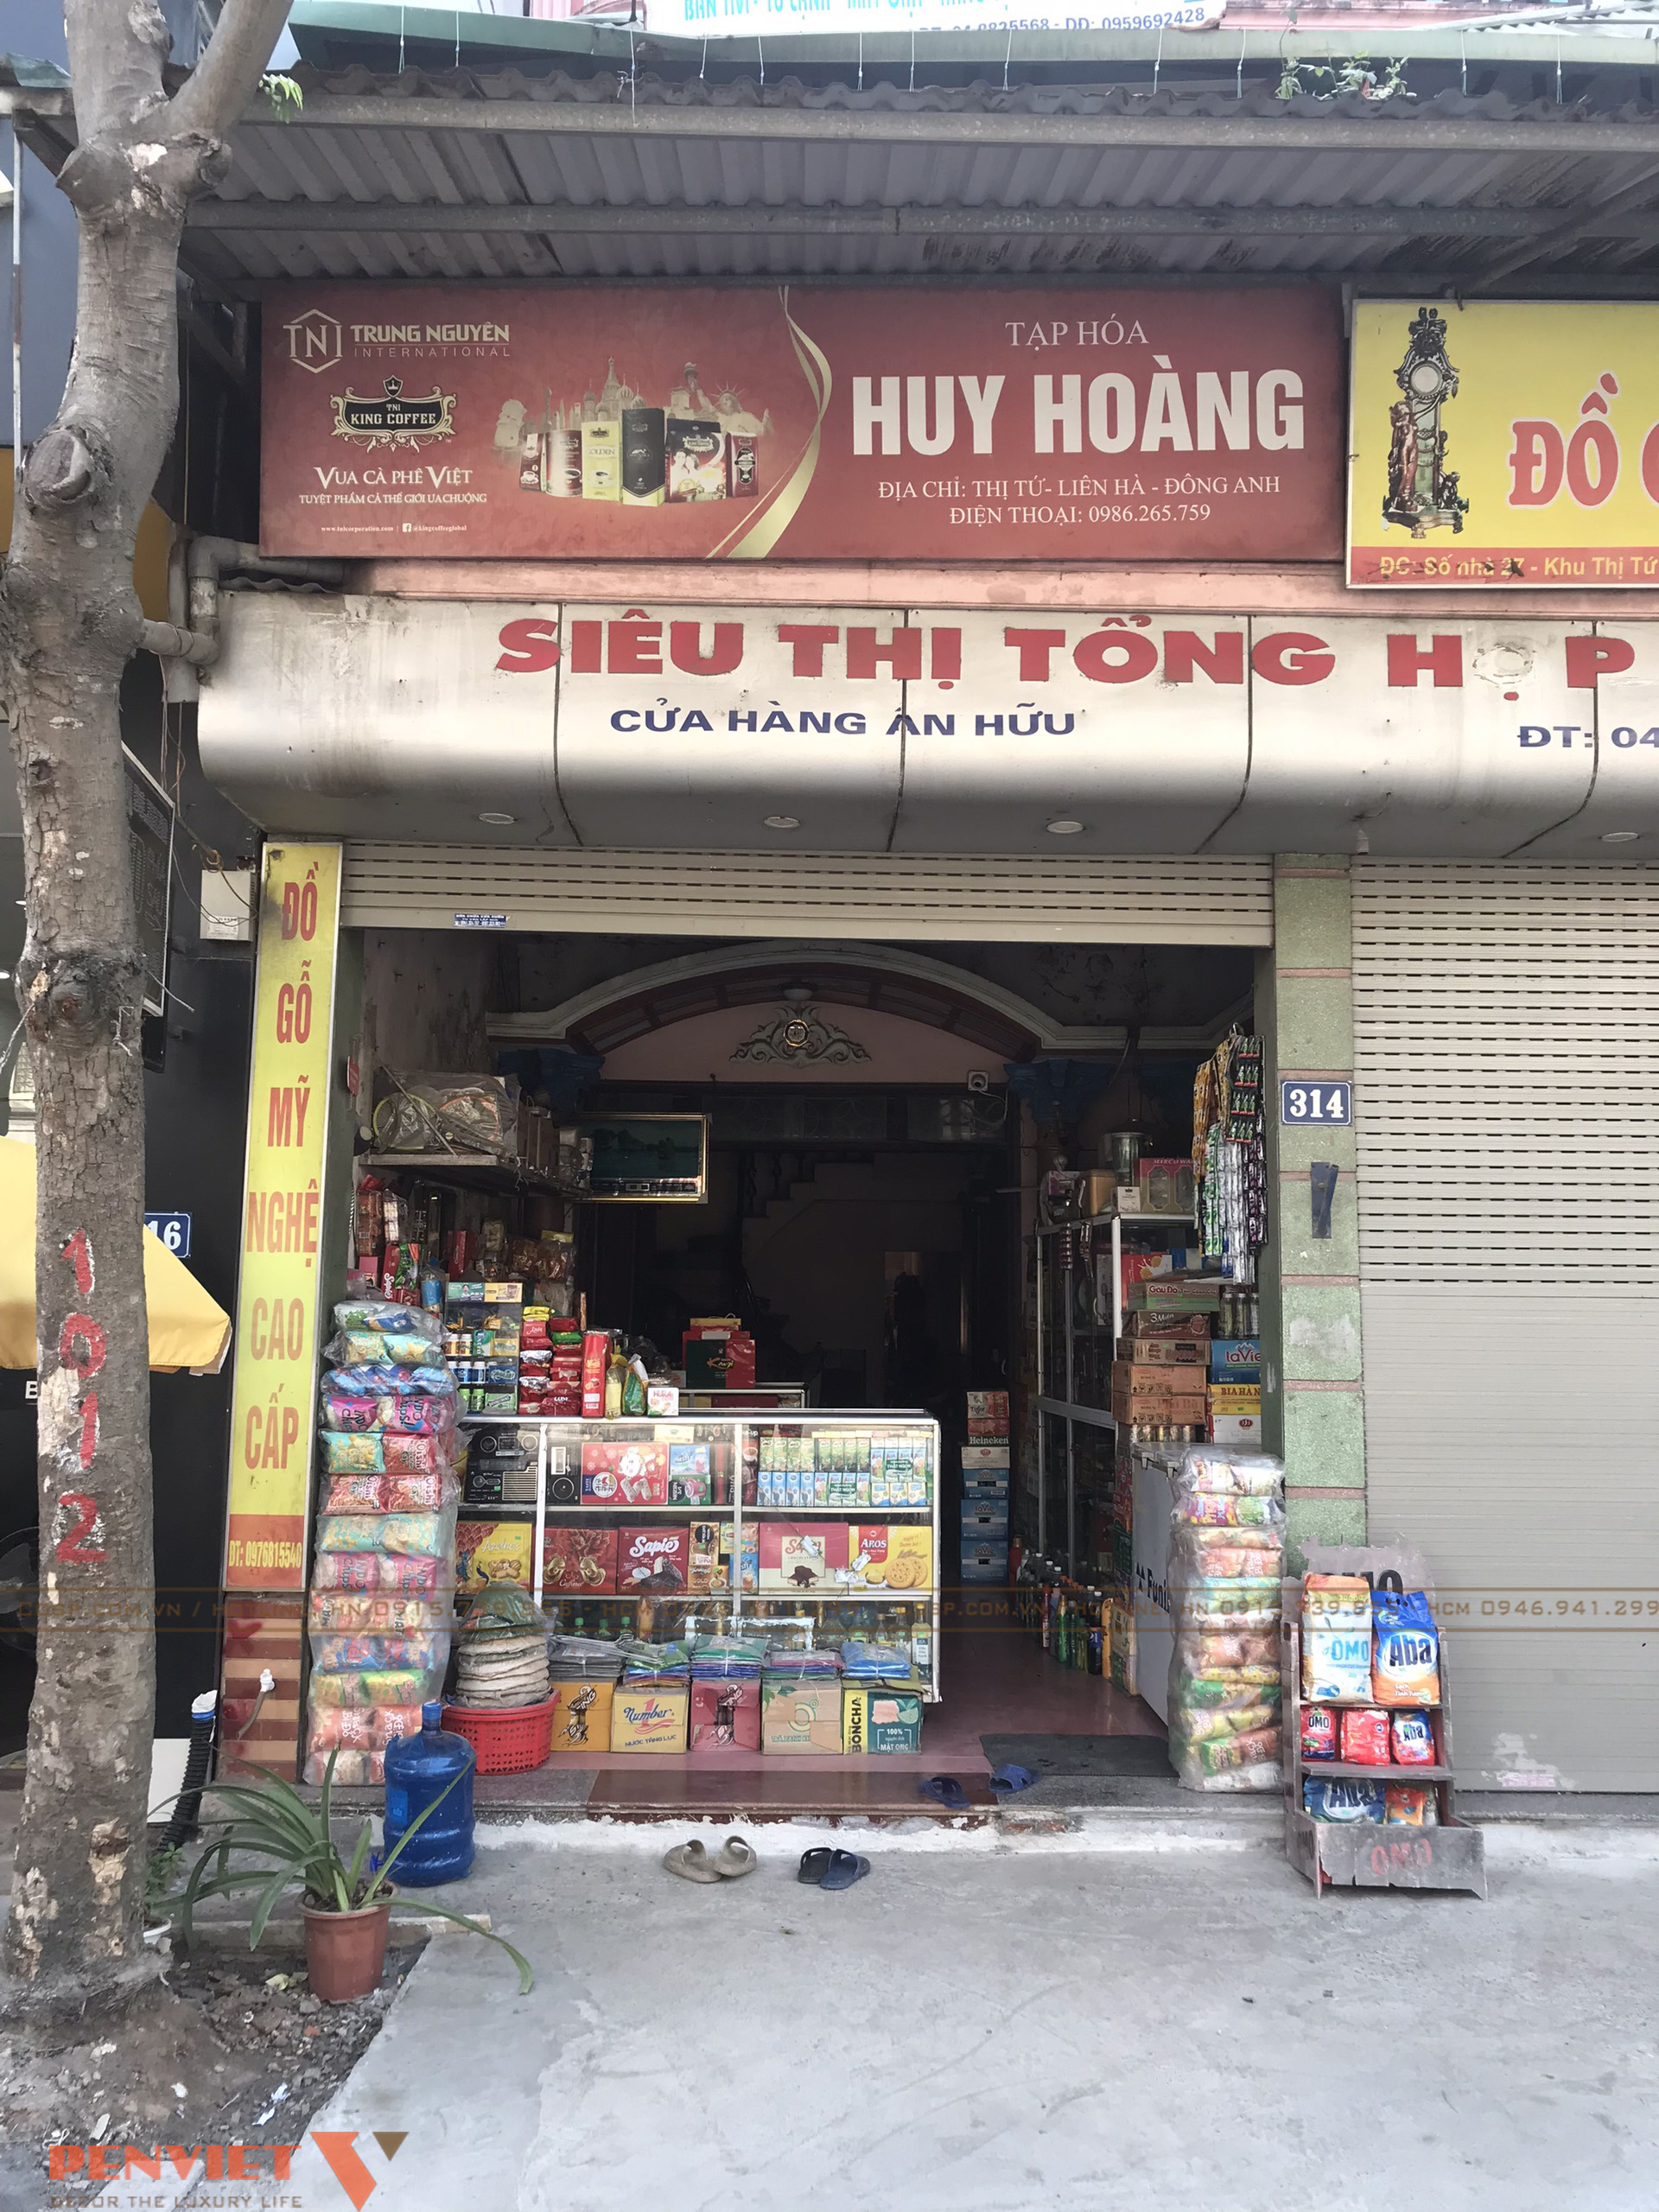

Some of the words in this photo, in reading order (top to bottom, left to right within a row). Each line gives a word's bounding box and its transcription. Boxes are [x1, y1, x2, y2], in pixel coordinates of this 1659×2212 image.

[1102, 8, 1205, 29] 0959692428
[283, 325, 343, 358] TNI
[350, 325, 421, 342] TRUNG
[426, 321, 510, 342] NGUYÊN
[1005, 321, 1068, 351] TẠP
[1077, 314, 1149, 346] HÓA
[354, 346, 510, 357] INTERNATIONAL
[351, 413, 382, 425] KING
[386, 413, 436, 424] COFFEE
[853, 374, 1006, 456] HUY
[1033, 354, 1305, 454] HOÀNG
[1508, 373, 1619, 507] ĐỒ
[363, 467, 387, 485] CÀ
[391, 467, 423, 484] PHÊ
[879, 480, 917, 501] ĐỊA
[922, 476, 966, 499] CHỈ:
[972, 480, 1009, 499] THỊ
[1058, 474, 1108, 498] LIÊN
[1114, 472, 1146, 496] HÀ
[1164, 473, 1228, 496] ĐÔNG
[1234, 475, 1281, 494] ANH
[299, 494, 332, 505] TUYỆT
[950, 504, 1003, 524] ĐIỆN
[1008, 504, 1083, 526] THOẠI:
[1089, 503, 1211, 524] 0986.265.759
[1424, 554, 1452, 576] Số
[1457, 555, 1495, 576] nhà
[1544, 556, 1585, 576] Khu
[1592, 556, 1624, 581] Thị
[1630, 555, 1657, 576] Tứ
[495, 608, 744, 677] SIÊU
[778, 624, 962, 690] THỊ
[1005, 614, 1336, 686] TỔNG
[610, 697, 720, 734] CỬA
[728, 700, 868, 734] HÀNG
[975, 702, 1074, 736] HỮU
[1516, 727, 1595, 748] ĐT:
[282, 861, 319, 942] ĐỒ
[276, 959, 313, 1044] GỖ
[267, 1074, 311, 1147] MỸ
[1288, 1089, 1344, 1119] 314
[246, 1178, 320, 1268] NGHỆ
[251, 1297, 305, 1362] CAO
[245, 1382, 299, 1470] CẤP
[969, 1436, 1009, 1445] Heineken
[245, 1541, 302, 1568] 0976815540
[861, 1538, 887, 1548] AROS
[1331, 1639, 1370, 1661] OMO
[1389, 1634, 1433, 1667] Aba
[1308, 1716, 1330, 1728] OMO
